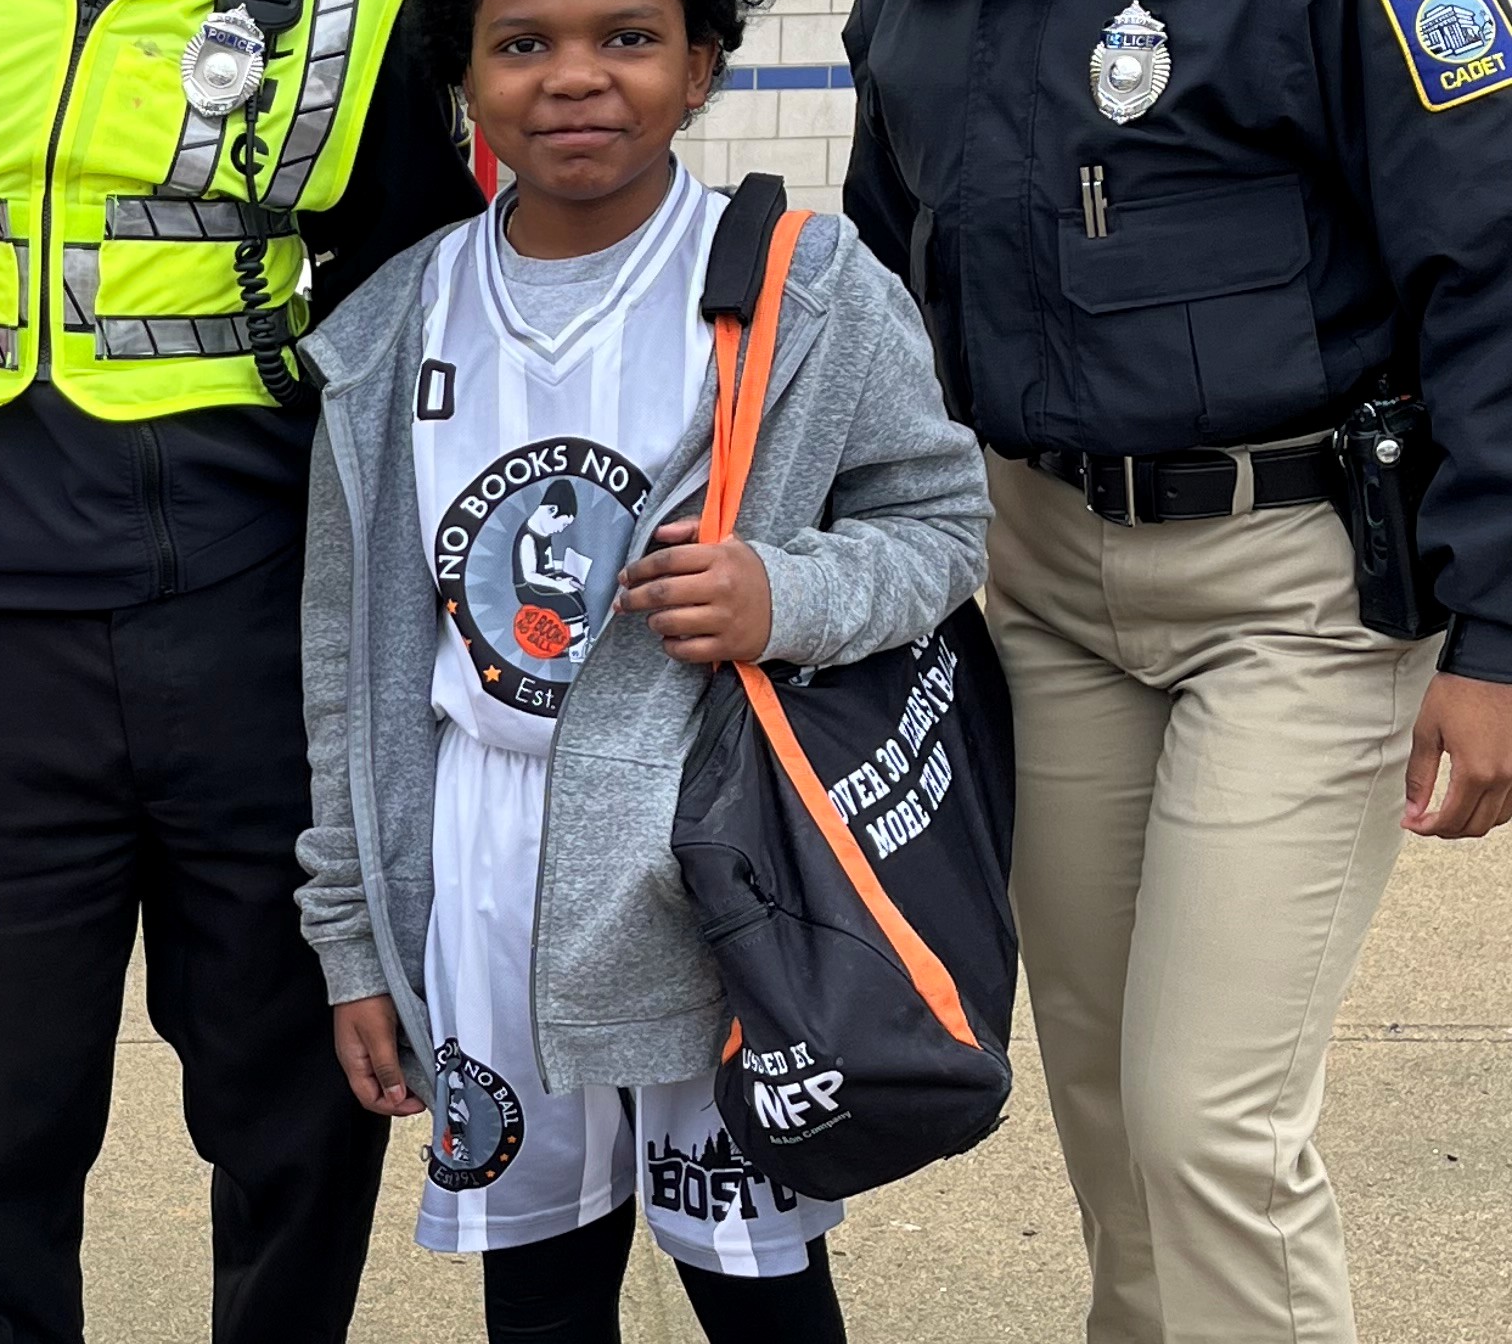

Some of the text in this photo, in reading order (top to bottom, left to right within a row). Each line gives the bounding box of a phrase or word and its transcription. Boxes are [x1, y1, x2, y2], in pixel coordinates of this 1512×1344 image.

[208, 28, 256, 53] POLICE
[1440, 53, 1506, 91] CADET
[438, 525, 470, 581] NO
[460, 444, 568, 520] BOOKS
[581, 448, 630, 493] NO
[515, 677, 556, 710] Est.
[828, 761, 891, 825] OVER
[876, 738, 910, 783] 30
[898, 686, 934, 759] YEARS
[865, 740, 953, 860] MORE THAN
[464, 1060, 519, 1128] NO BALL
[754, 1070, 844, 1130] NFP
[802, 1110, 852, 1139] Company
